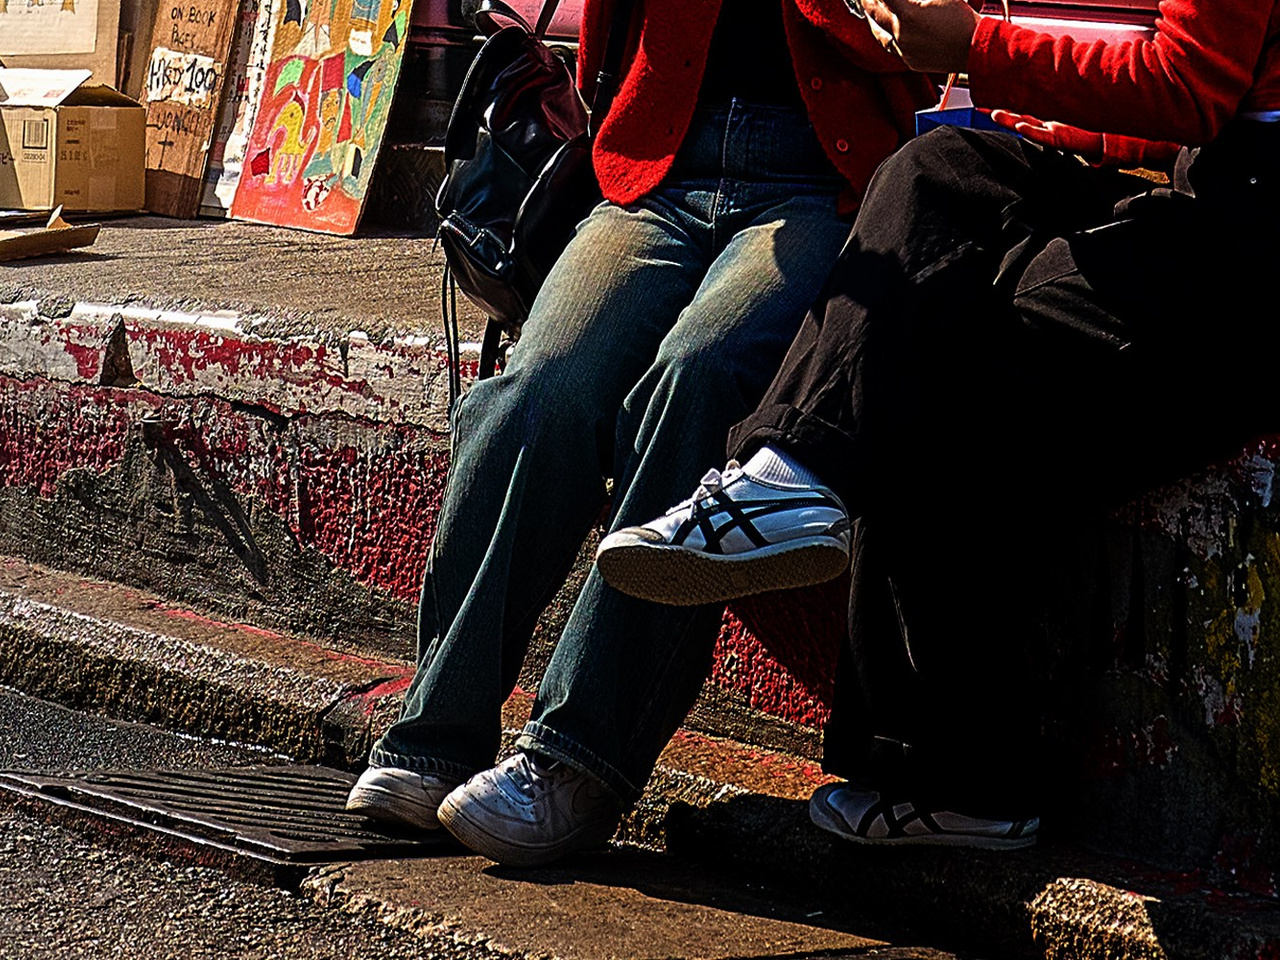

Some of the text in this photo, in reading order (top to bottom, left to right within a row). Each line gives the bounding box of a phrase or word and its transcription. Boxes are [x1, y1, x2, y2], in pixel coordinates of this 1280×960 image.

[170, 6, 217, 27] ON BOOK
[185, 58, 219, 93] 100
